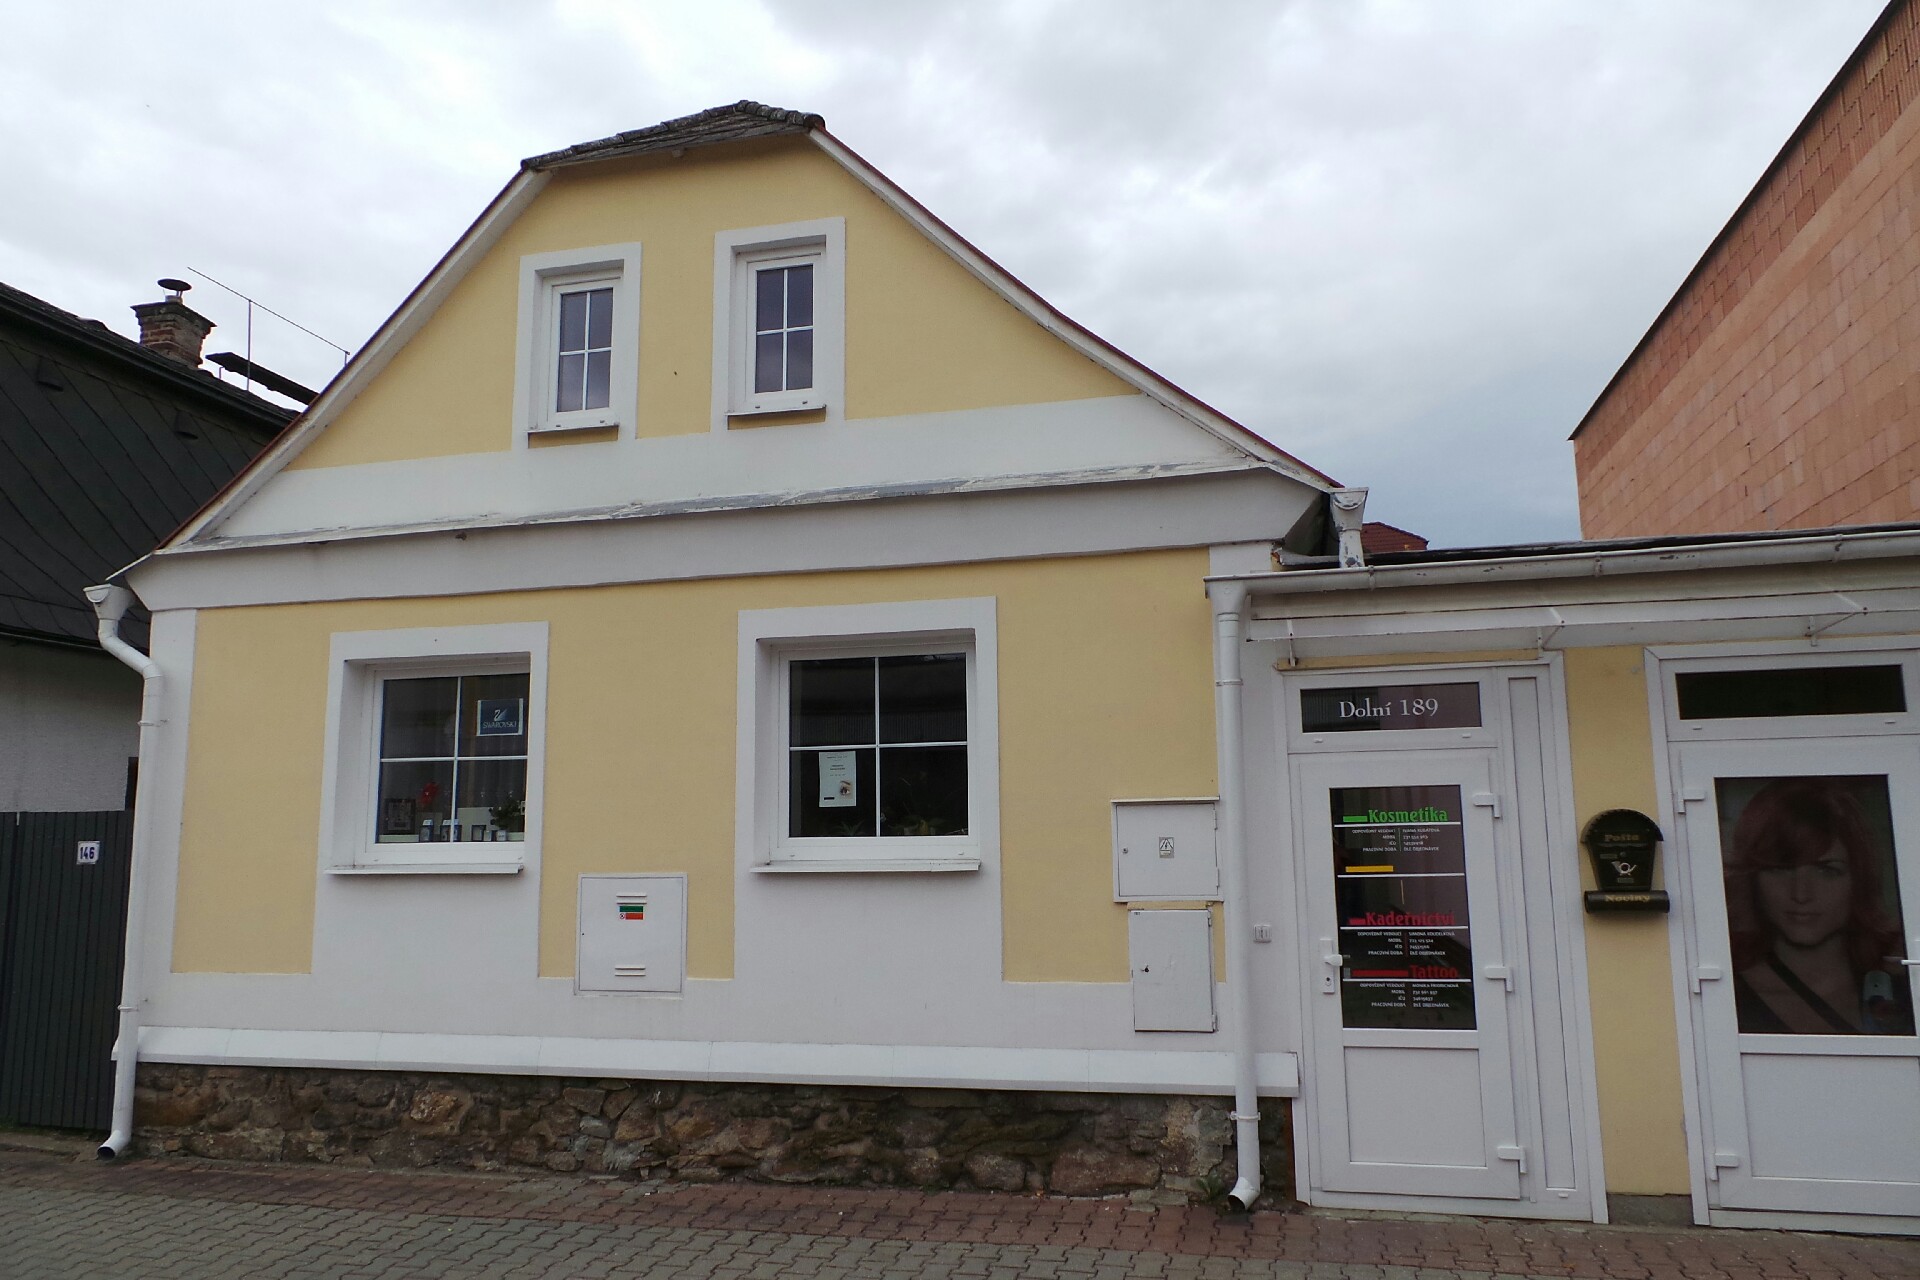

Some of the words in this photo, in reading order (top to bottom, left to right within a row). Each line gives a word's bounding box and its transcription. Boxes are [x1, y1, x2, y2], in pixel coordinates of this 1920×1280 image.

[1339, 697, 1392, 718] Dolní
[1399, 698, 1439, 717] 189
[482, 720, 517, 729] SWAROVSKI
[1368, 807, 1448, 823] Kosmetika
[80, 846, 95, 860] 146
[1604, 894, 1650, 903] Noviny
[1410, 964, 1459, 979] Tattoo
